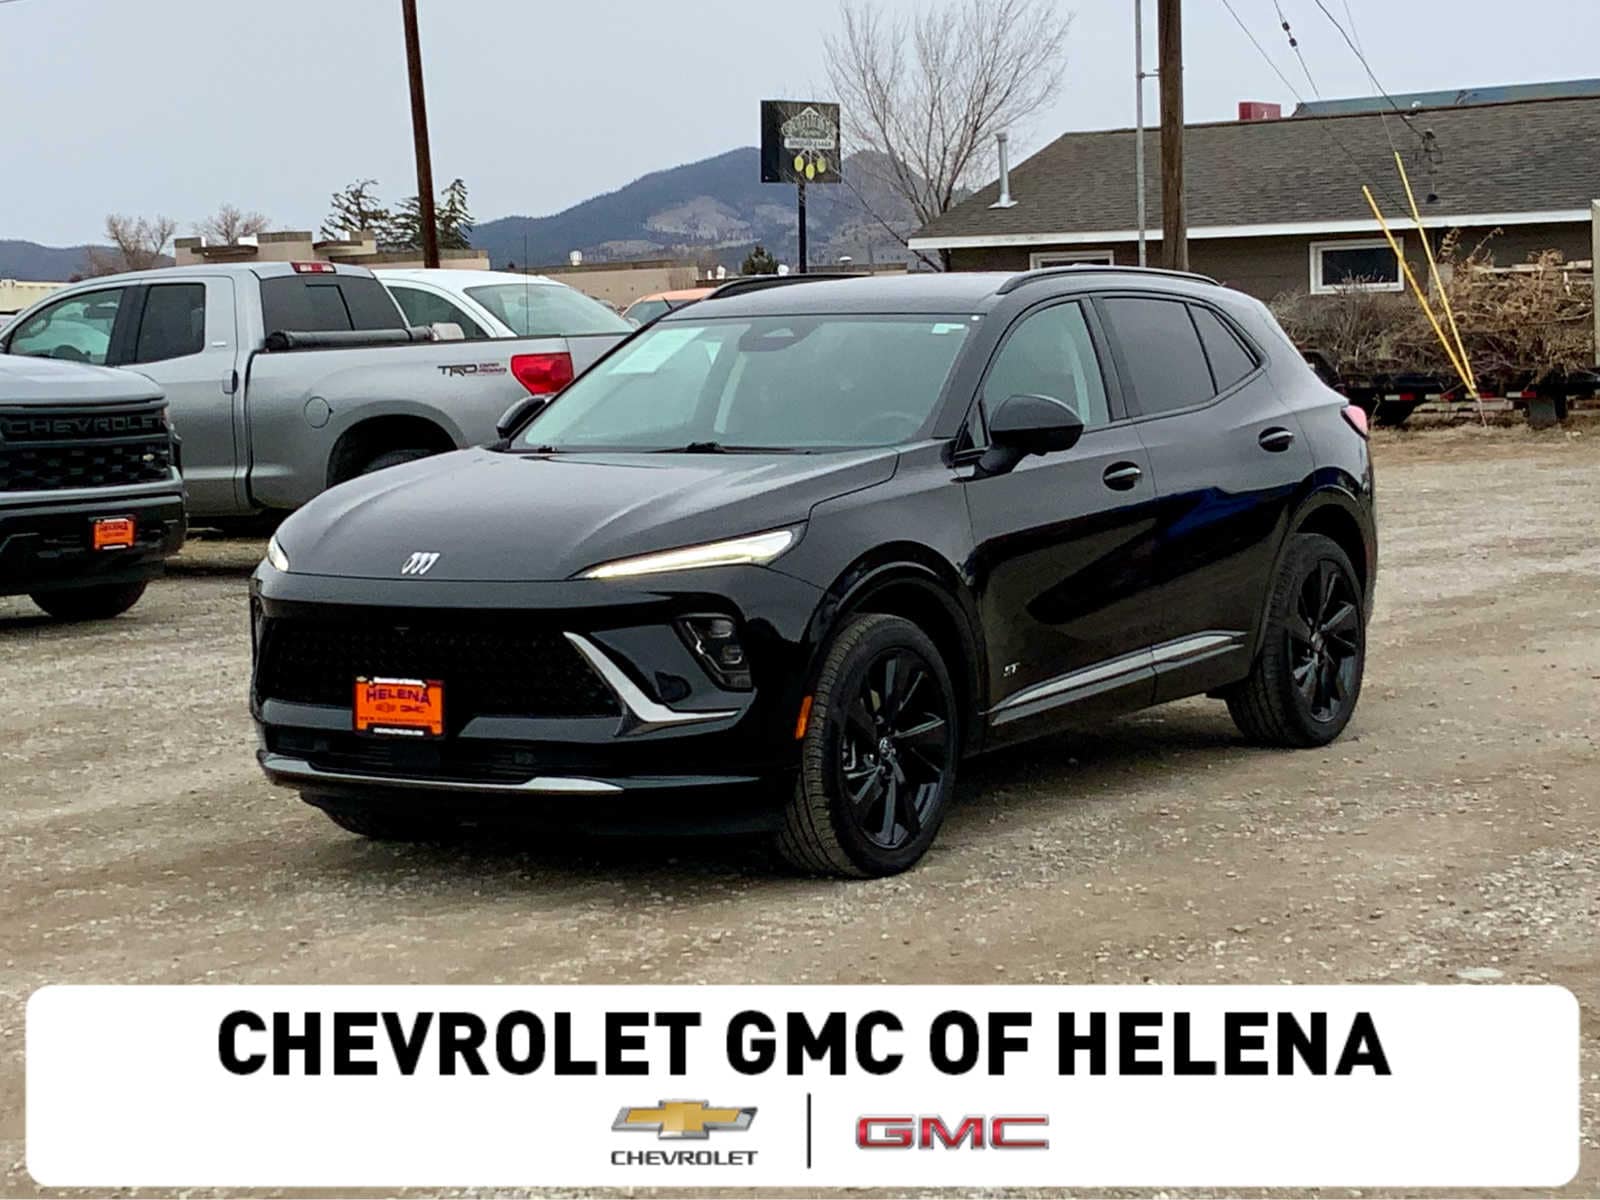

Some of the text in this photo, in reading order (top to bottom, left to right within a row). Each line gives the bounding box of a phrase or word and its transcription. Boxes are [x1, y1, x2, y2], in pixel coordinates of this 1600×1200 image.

[437, 364, 478, 377] TRD
[7, 414, 165, 433] CHEVROLET
[366, 684, 432, 707] HELENA
